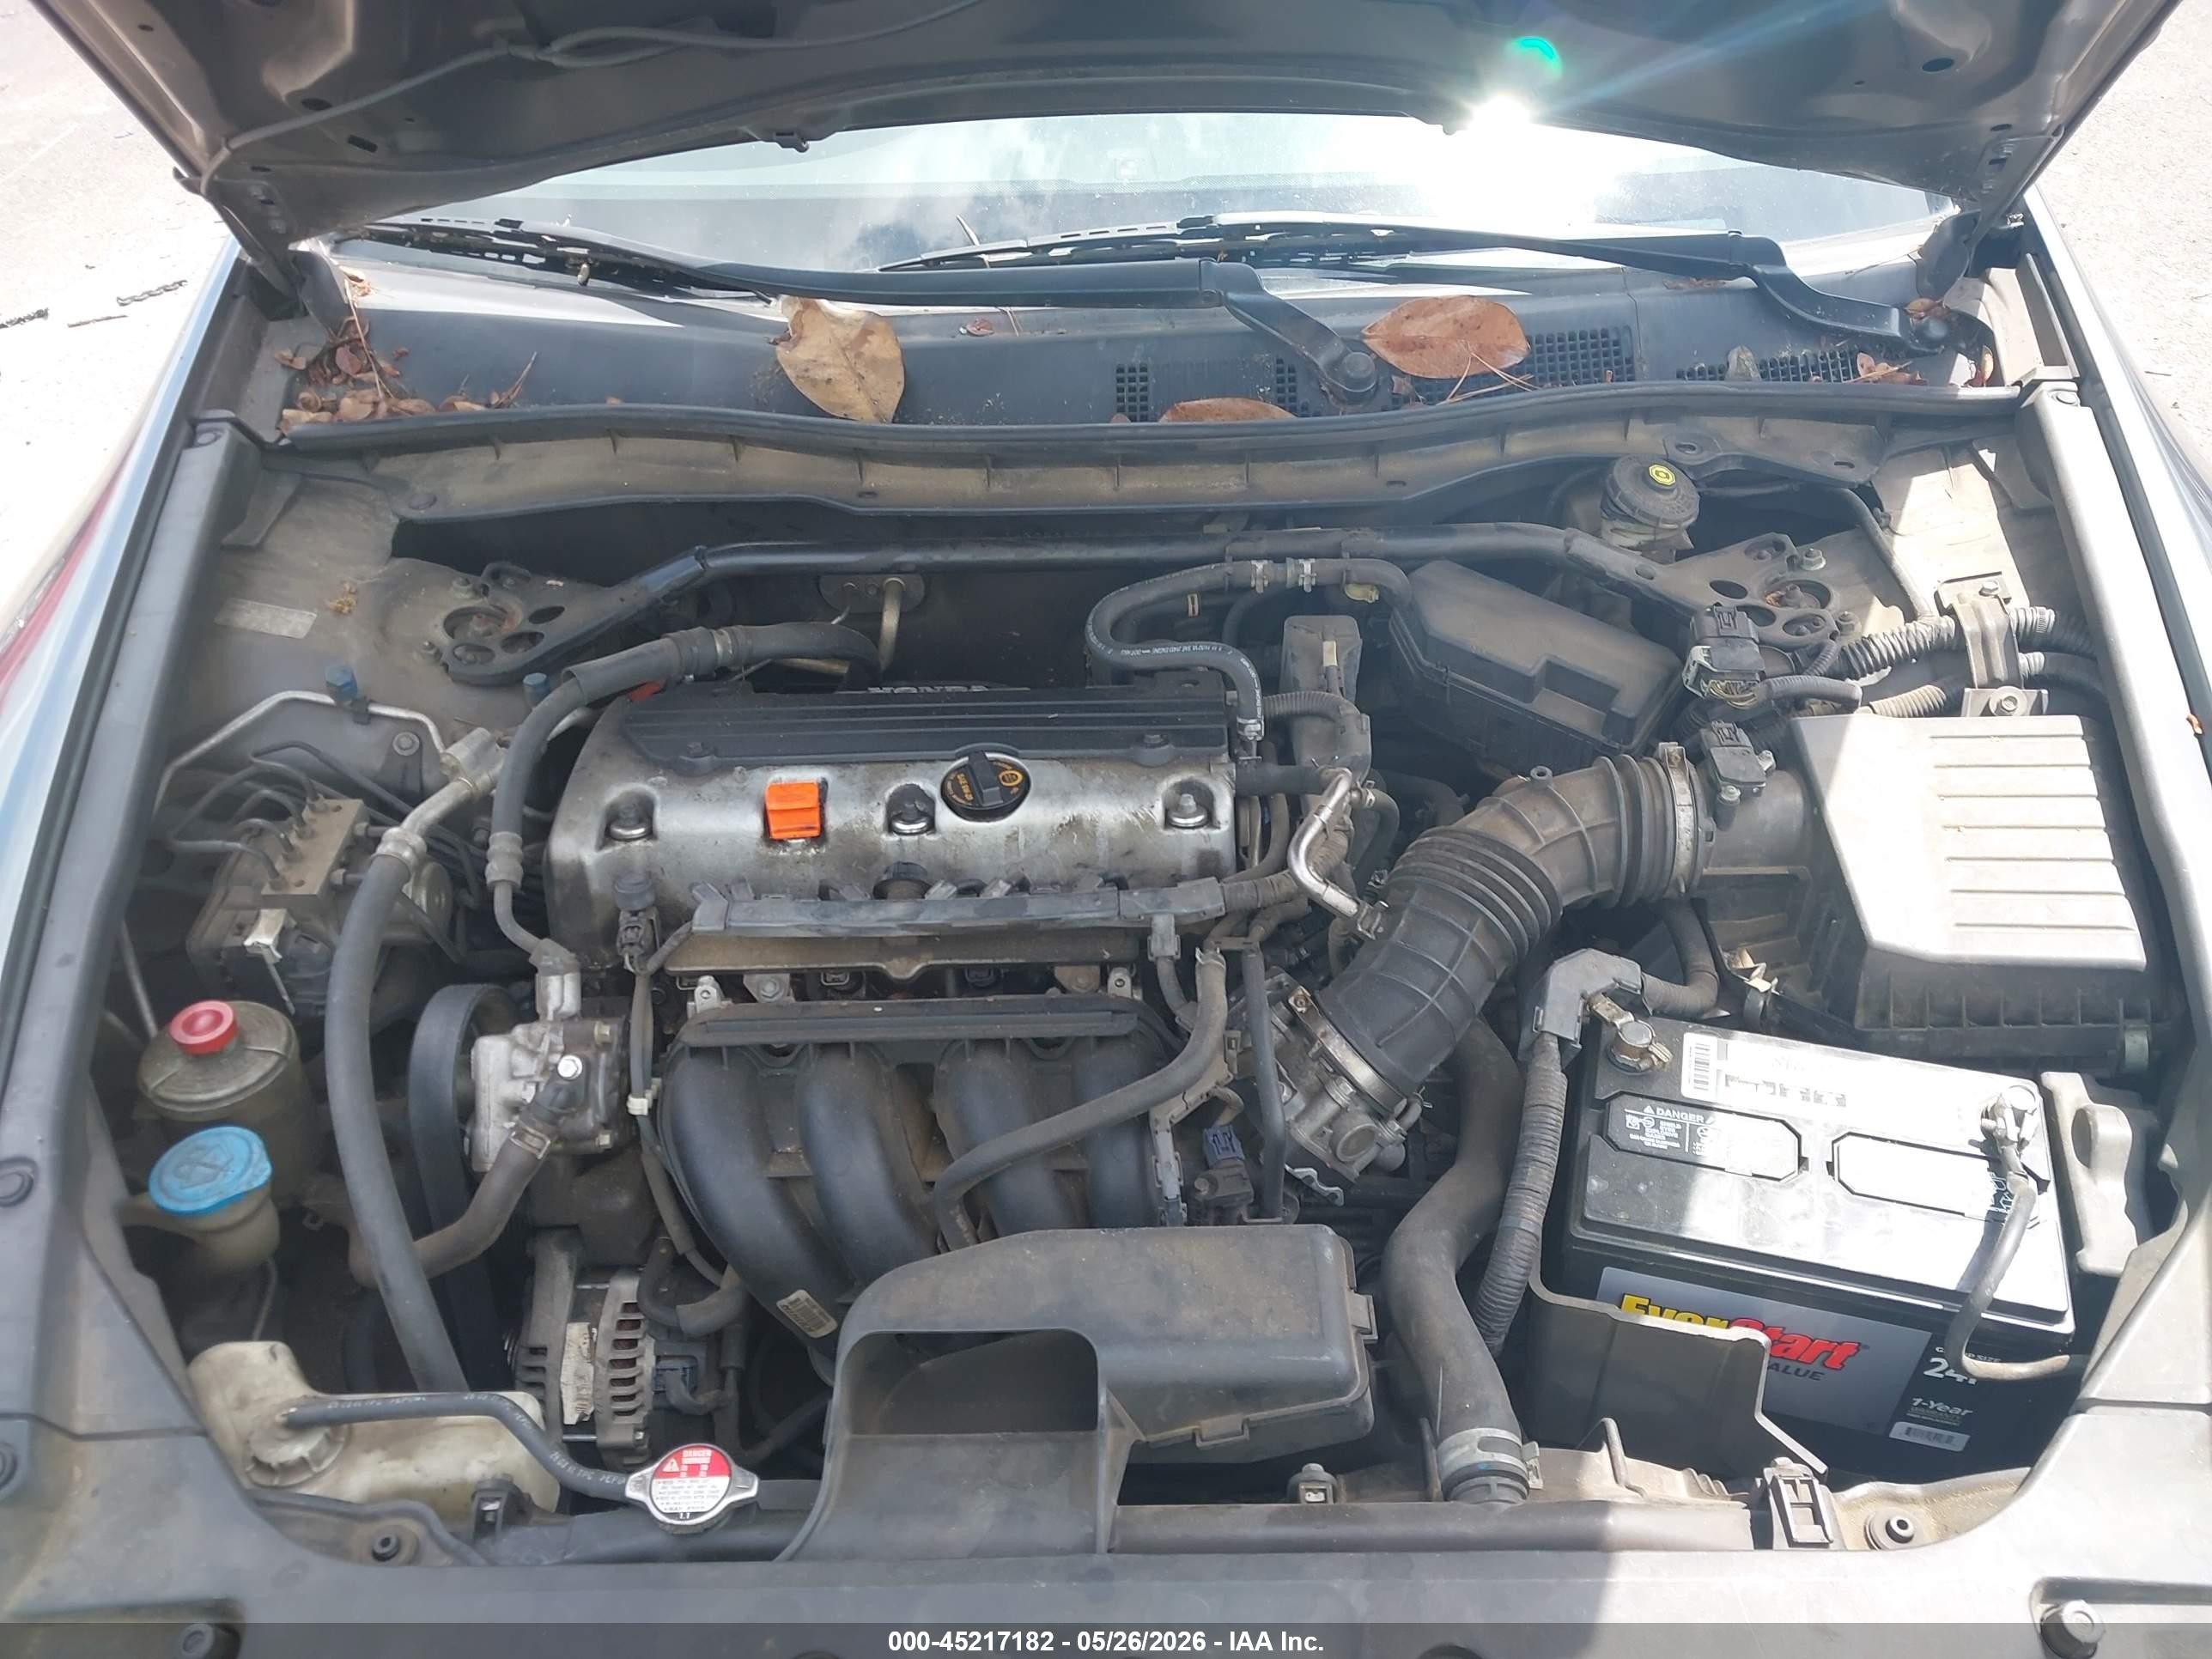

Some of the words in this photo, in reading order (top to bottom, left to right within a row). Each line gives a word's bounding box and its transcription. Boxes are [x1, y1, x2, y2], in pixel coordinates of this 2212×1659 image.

[1656, 1107, 1705, 1123] DANGER
[1620, 1293, 1860, 1370] Evertart
[1766, 1362, 1826, 1382] ALUE
[1923, 1358, 1978, 1385] 24
[1911, 1397, 1973, 1416] 1-Year
